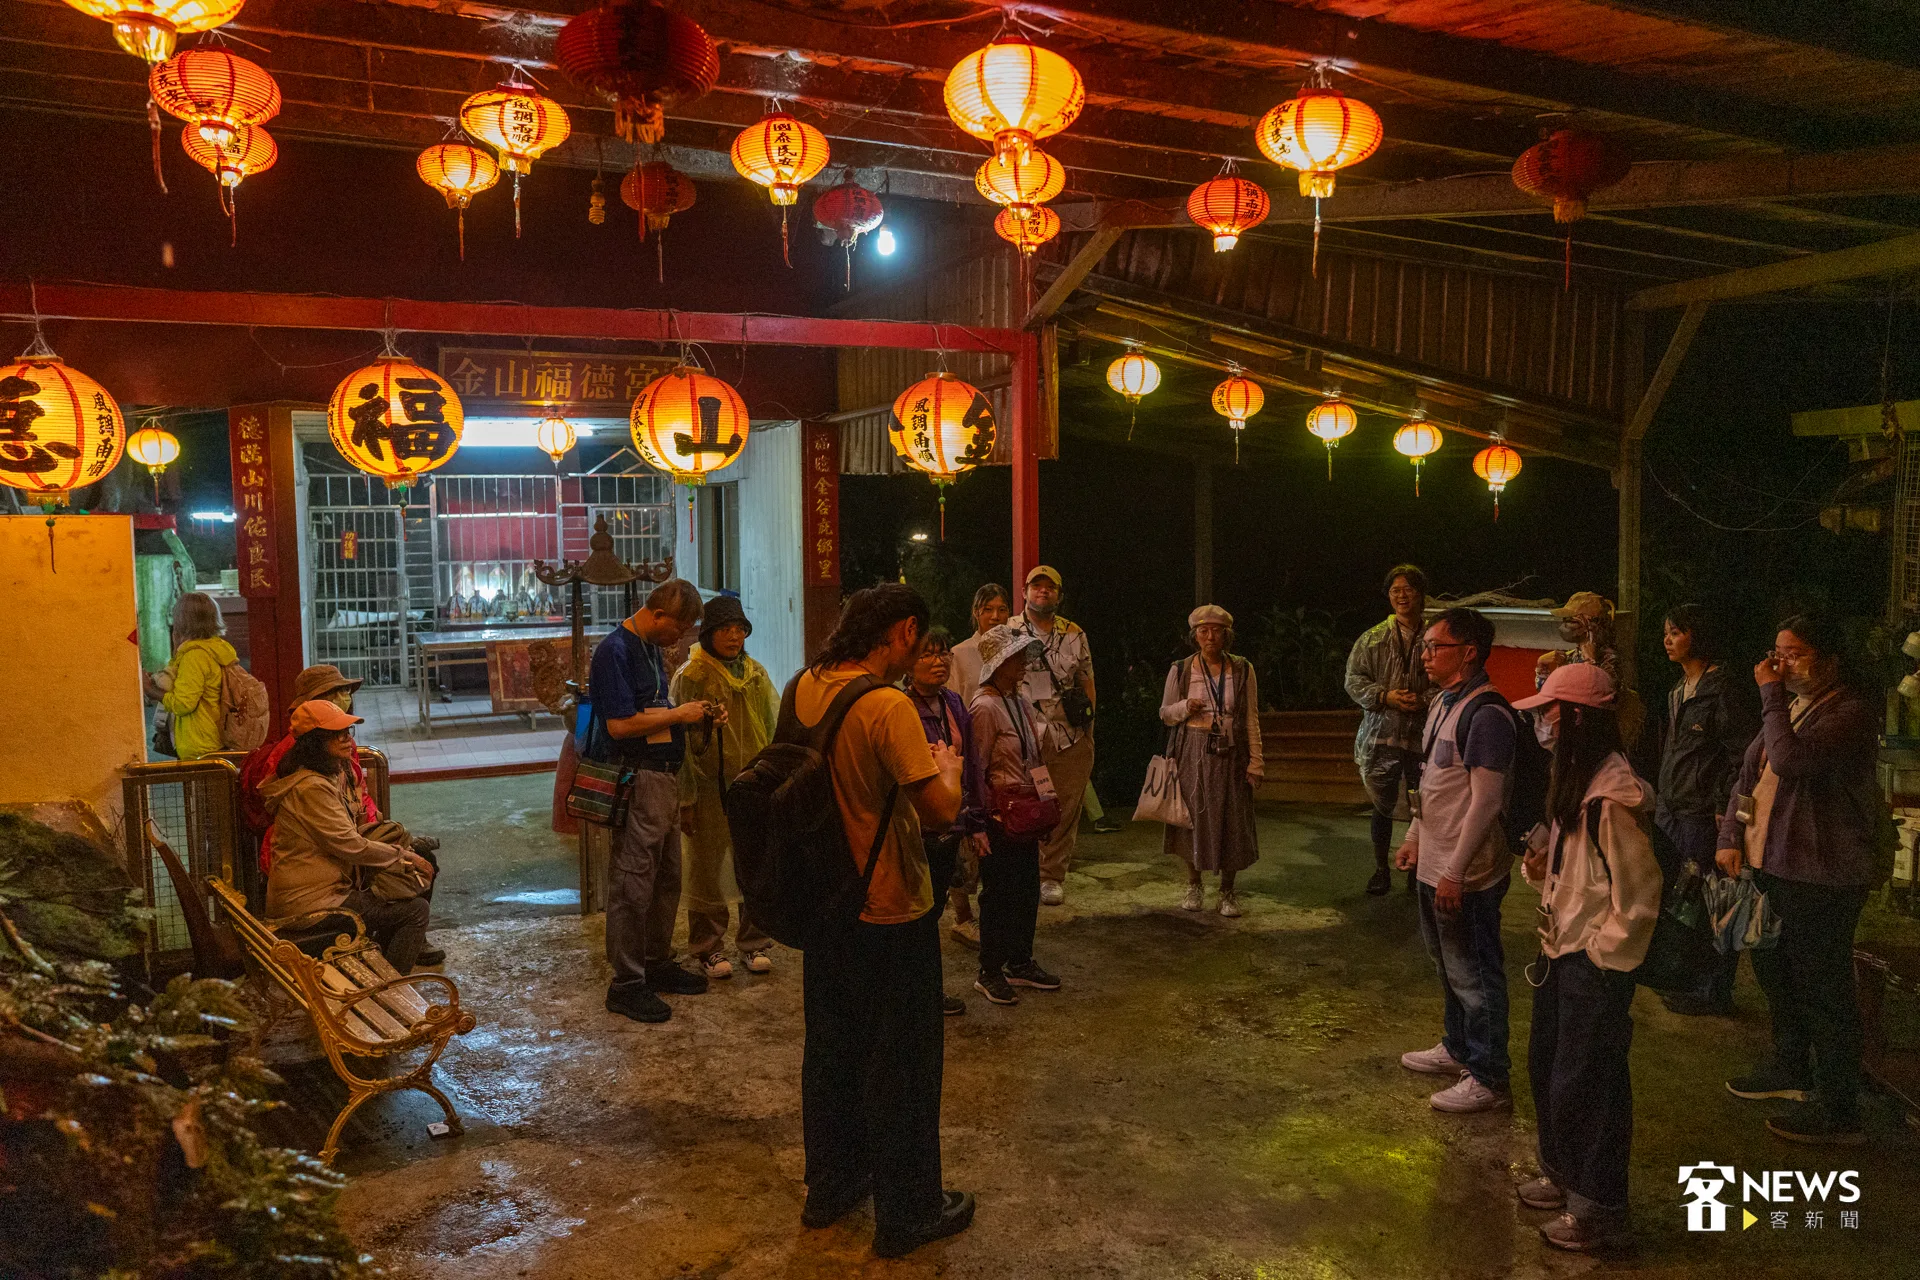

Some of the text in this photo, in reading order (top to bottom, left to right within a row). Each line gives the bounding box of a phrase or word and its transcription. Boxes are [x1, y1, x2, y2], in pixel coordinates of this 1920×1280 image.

[773, 123, 798, 168] 國泰民安
[450, 357, 660, 401] 金山福德宮
[86, 391, 115, 477] 風調雨順
[348, 377, 457, 462] 福
[673, 396, 743, 458] 山
[911, 397, 936, 463] 風調雨順
